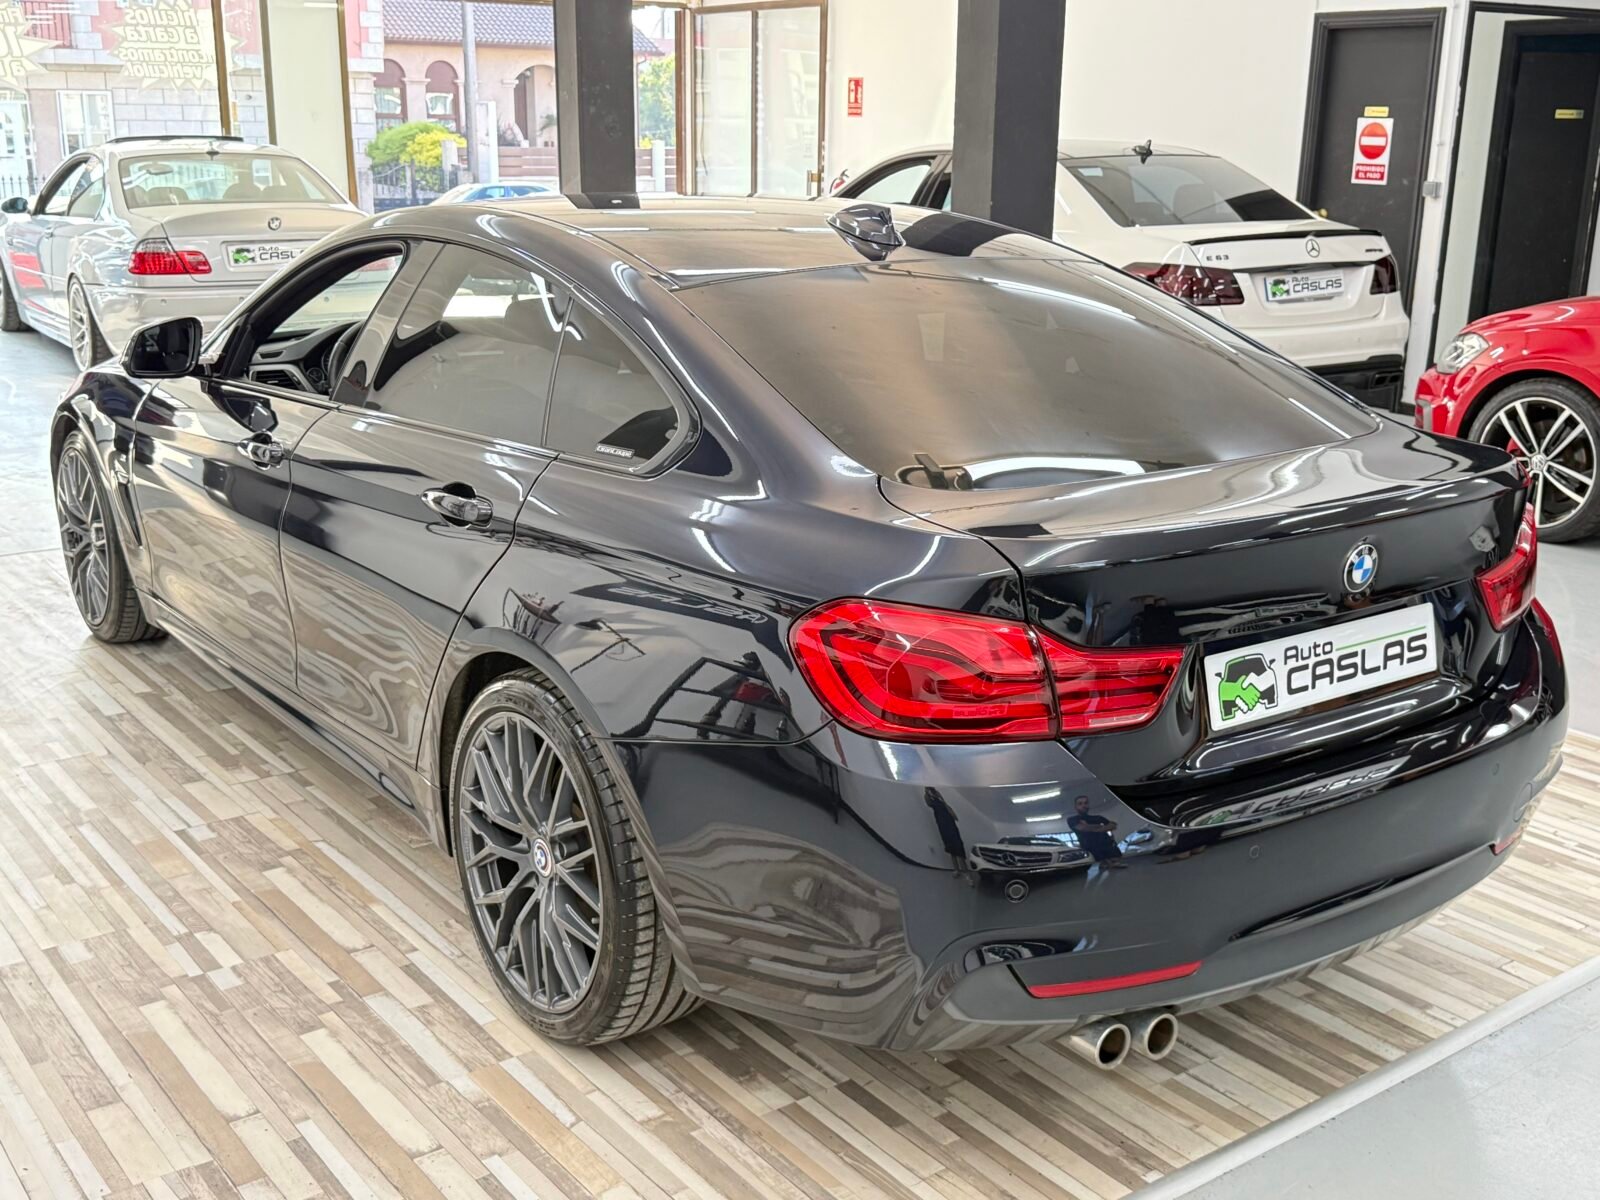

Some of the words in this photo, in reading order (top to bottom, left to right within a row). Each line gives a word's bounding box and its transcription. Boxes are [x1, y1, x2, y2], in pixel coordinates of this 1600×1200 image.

[259, 250, 305, 261] CASL
[1292, 278, 1342, 293] CASLAS
[1283, 641, 1334, 666] Auto
[1286, 632, 1428, 696] CASLAS
